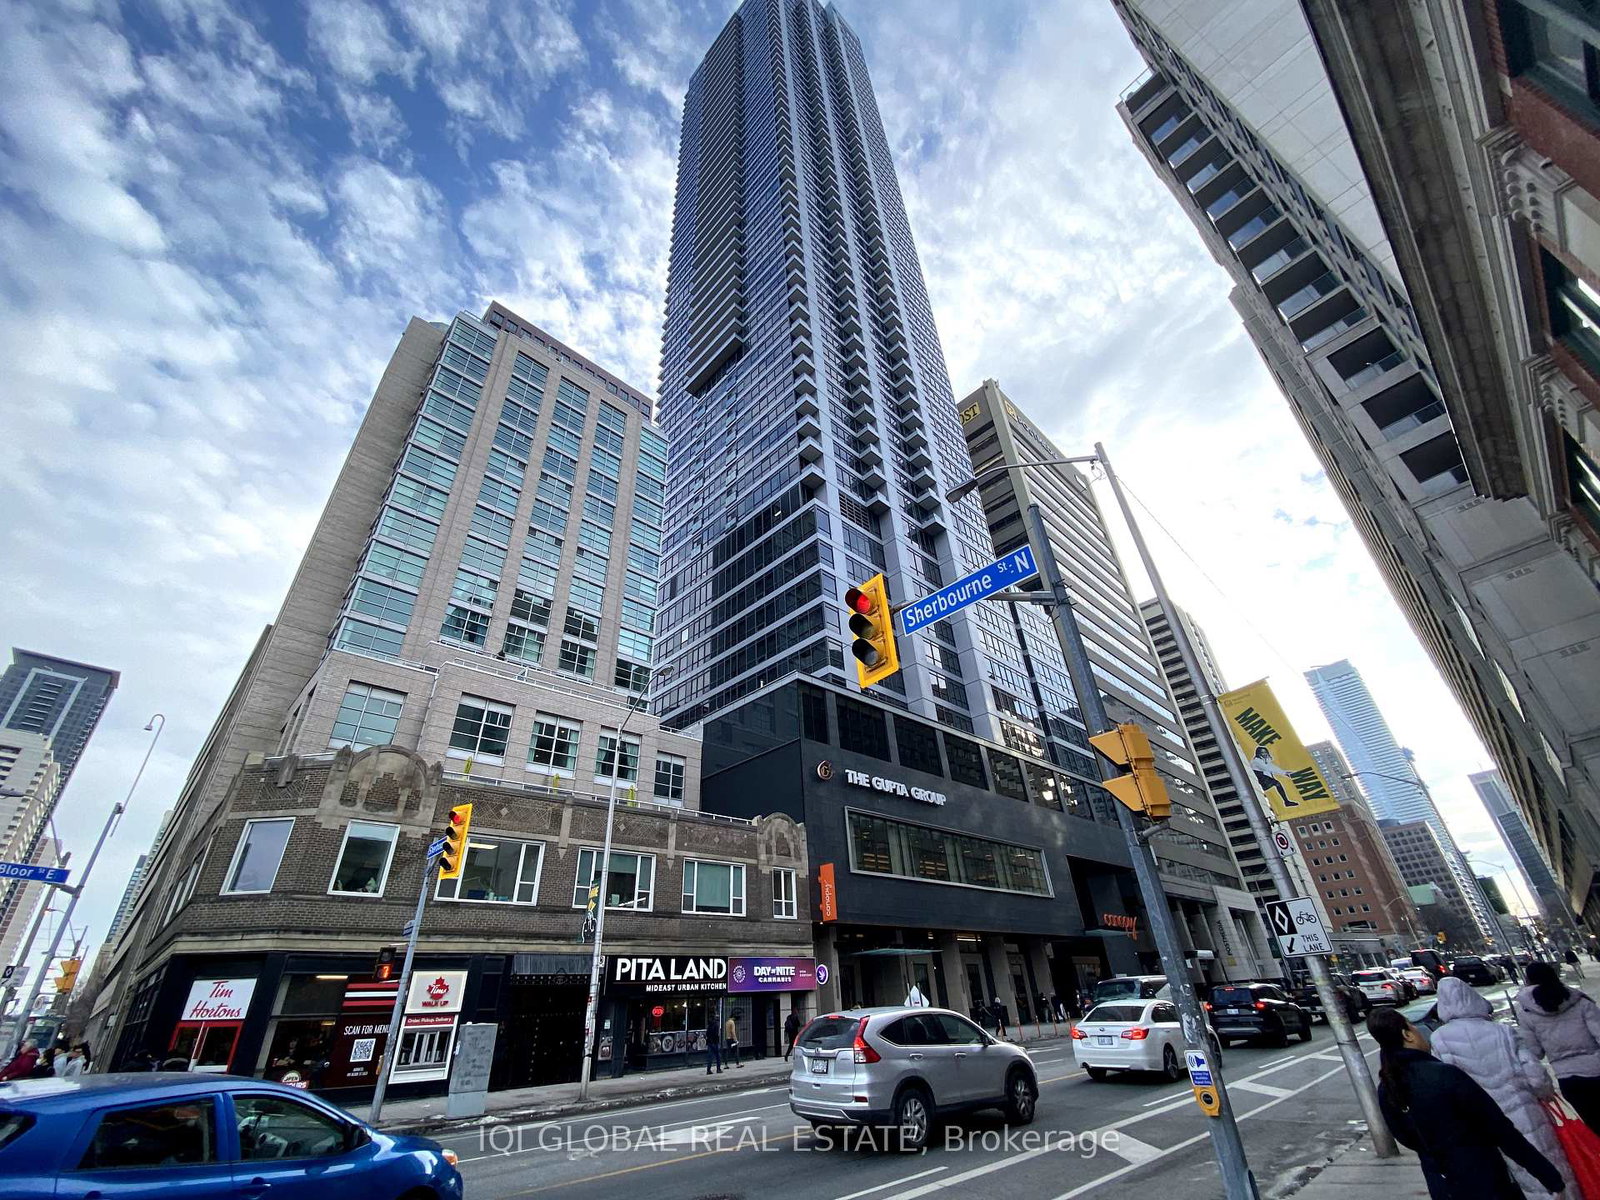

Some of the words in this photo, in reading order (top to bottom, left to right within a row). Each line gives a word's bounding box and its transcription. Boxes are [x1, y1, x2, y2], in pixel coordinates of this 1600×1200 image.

[906, 574, 992, 627] Sherbourne
[997, 562, 1008, 573] St
[1014, 551, 1030, 573] N
[1234, 706, 1282, 746] MAKE
[845, 769, 870, 787] THE
[871, 776, 909, 797] GUPTA
[910, 786, 946, 806] GROUP
[1290, 766, 1330, 801] WAY
[0, 863, 34, 877] Bloor
[46, 869, 56, 879] E
[824, 880, 833, 917] canopy
[1301, 933, 1319, 943] THIS
[1303, 943, 1325, 953] LANE
[615, 958, 666, 981] PITA
[669, 958, 727, 980] LAND
[209, 980, 233, 998] Tim
[645, 984, 675, 992] MIDEAST
[677, 983, 699, 991] URBAN
[700, 982, 727, 990] KITCHEN
[189, 1000, 242, 1018] Hortons
[343, 1025, 360, 1035] SCAN
[361, 1024, 373, 1034] FOR
